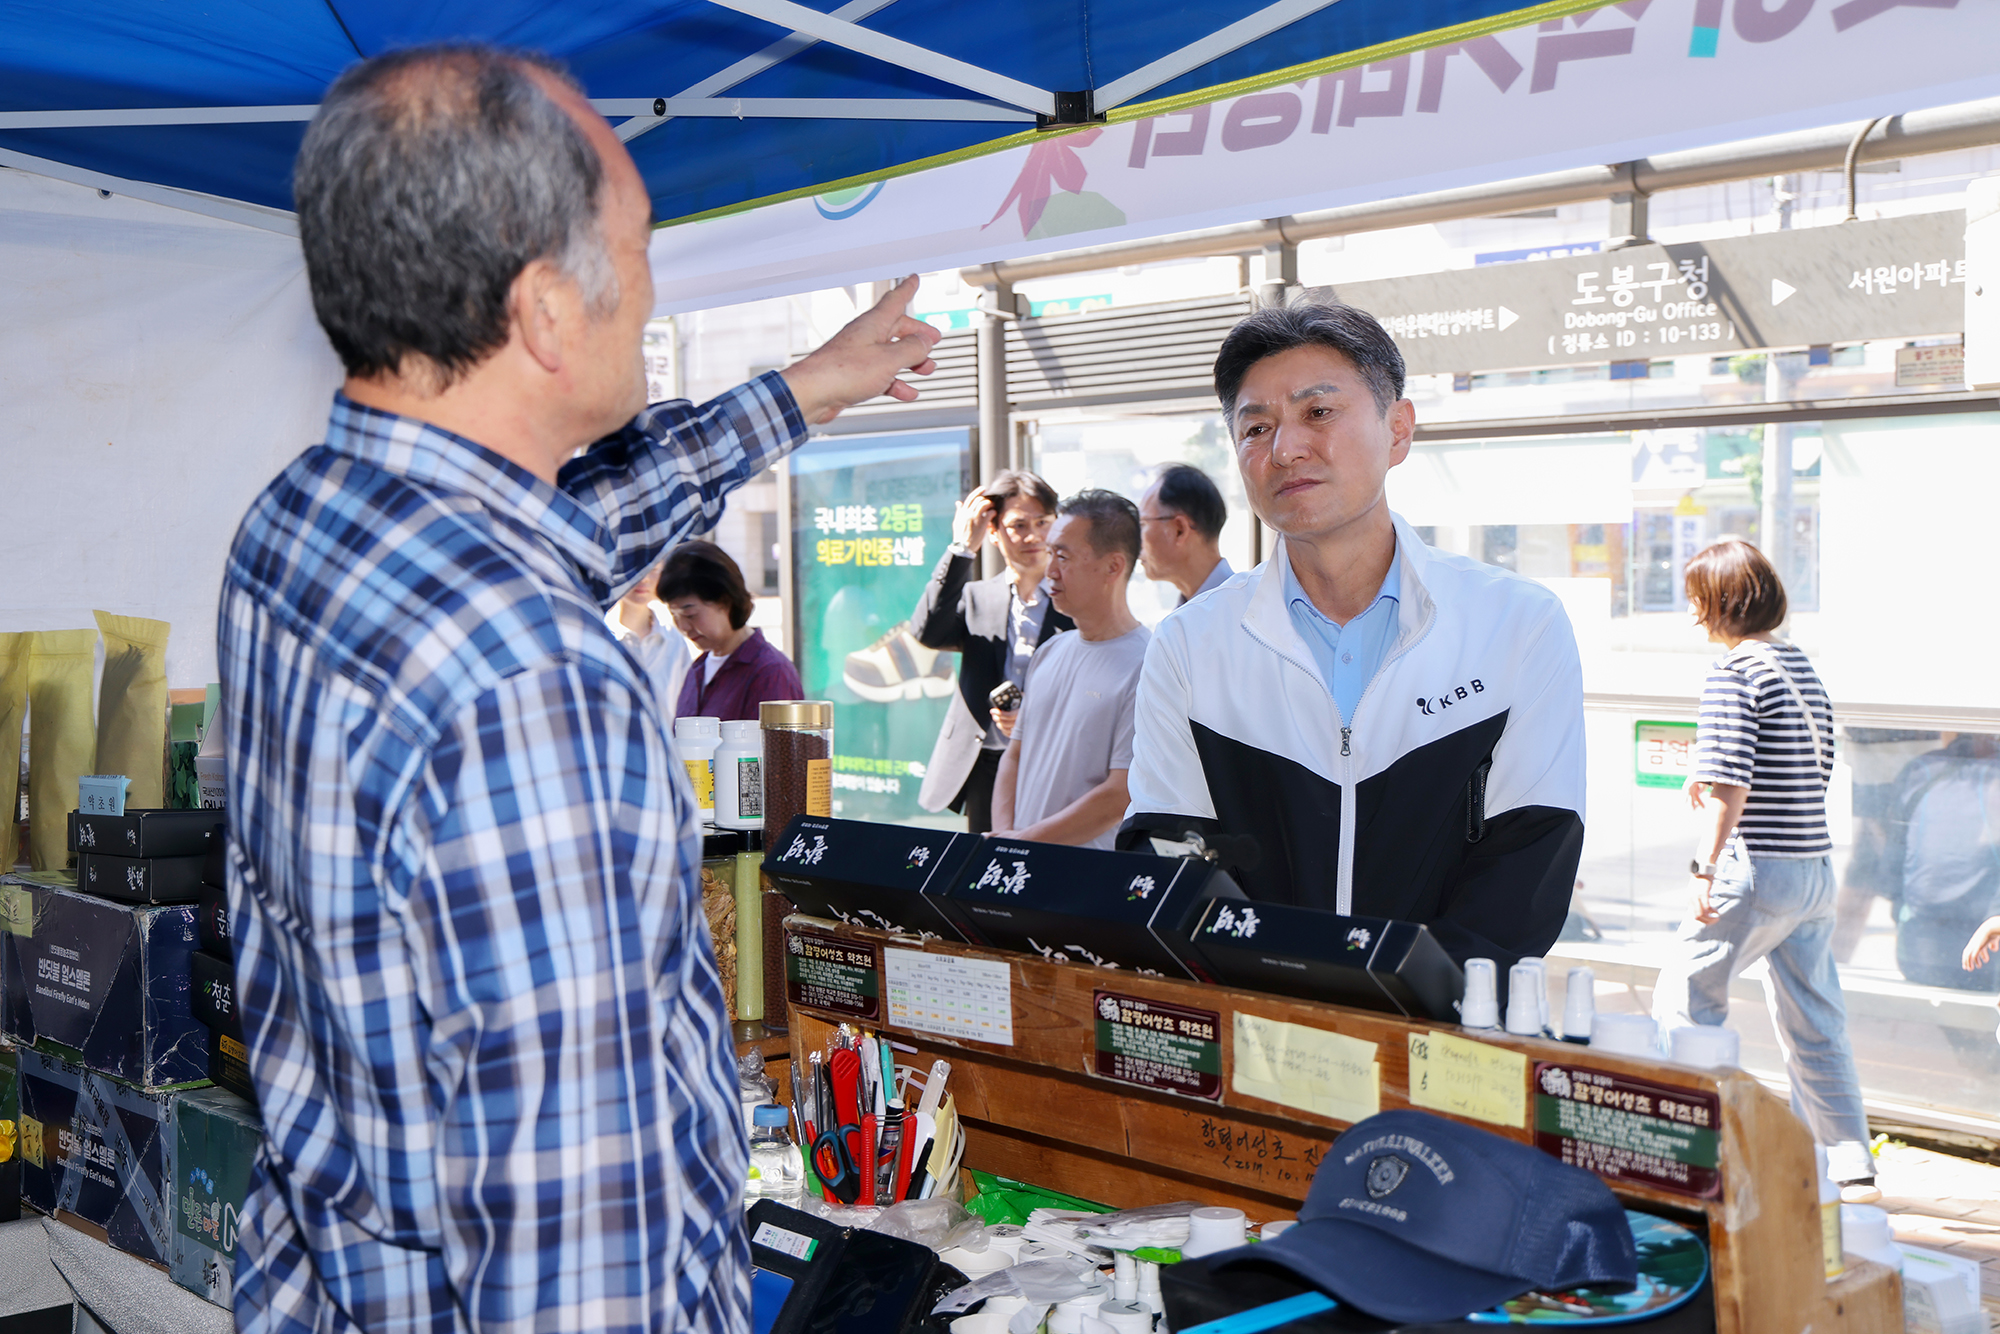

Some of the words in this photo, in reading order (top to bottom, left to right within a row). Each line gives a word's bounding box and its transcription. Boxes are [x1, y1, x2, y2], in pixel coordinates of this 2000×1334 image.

[1572, 256, 1709, 307] 도봉구청
[1848, 259, 1965, 295] 서원아파트
[1565, 305, 1657, 329] Dobong-Gu
[1662, 301, 1718, 321] Office
[1562, 333, 1610, 354] 정류소
[1616, 330, 1636, 347] ID
[1659, 322, 1721, 344] 10-133
[814, 505, 878, 535] 국내최초
[879, 503, 924, 533] 2등급
[1439, 679, 1485, 710] KBB
[805, 944, 844, 961] 함평어성초
[847, 952, 872, 967] 약초원
[38, 957, 60, 983] 반딧불
[61, 964, 91, 993] 얼스멜론
[211, 979, 232, 1014] 청춘
[1121, 1008, 1175, 1031] 함평어성초
[1179, 1020, 1214, 1040] 약초원
[1573, 1082, 1652, 1113] 함평어성초
[1659, 1099, 1709, 1126] 약초원
[83, 1139, 115, 1171] 얼스멜론
[1202, 1118, 1298, 1161] 함평어성초
